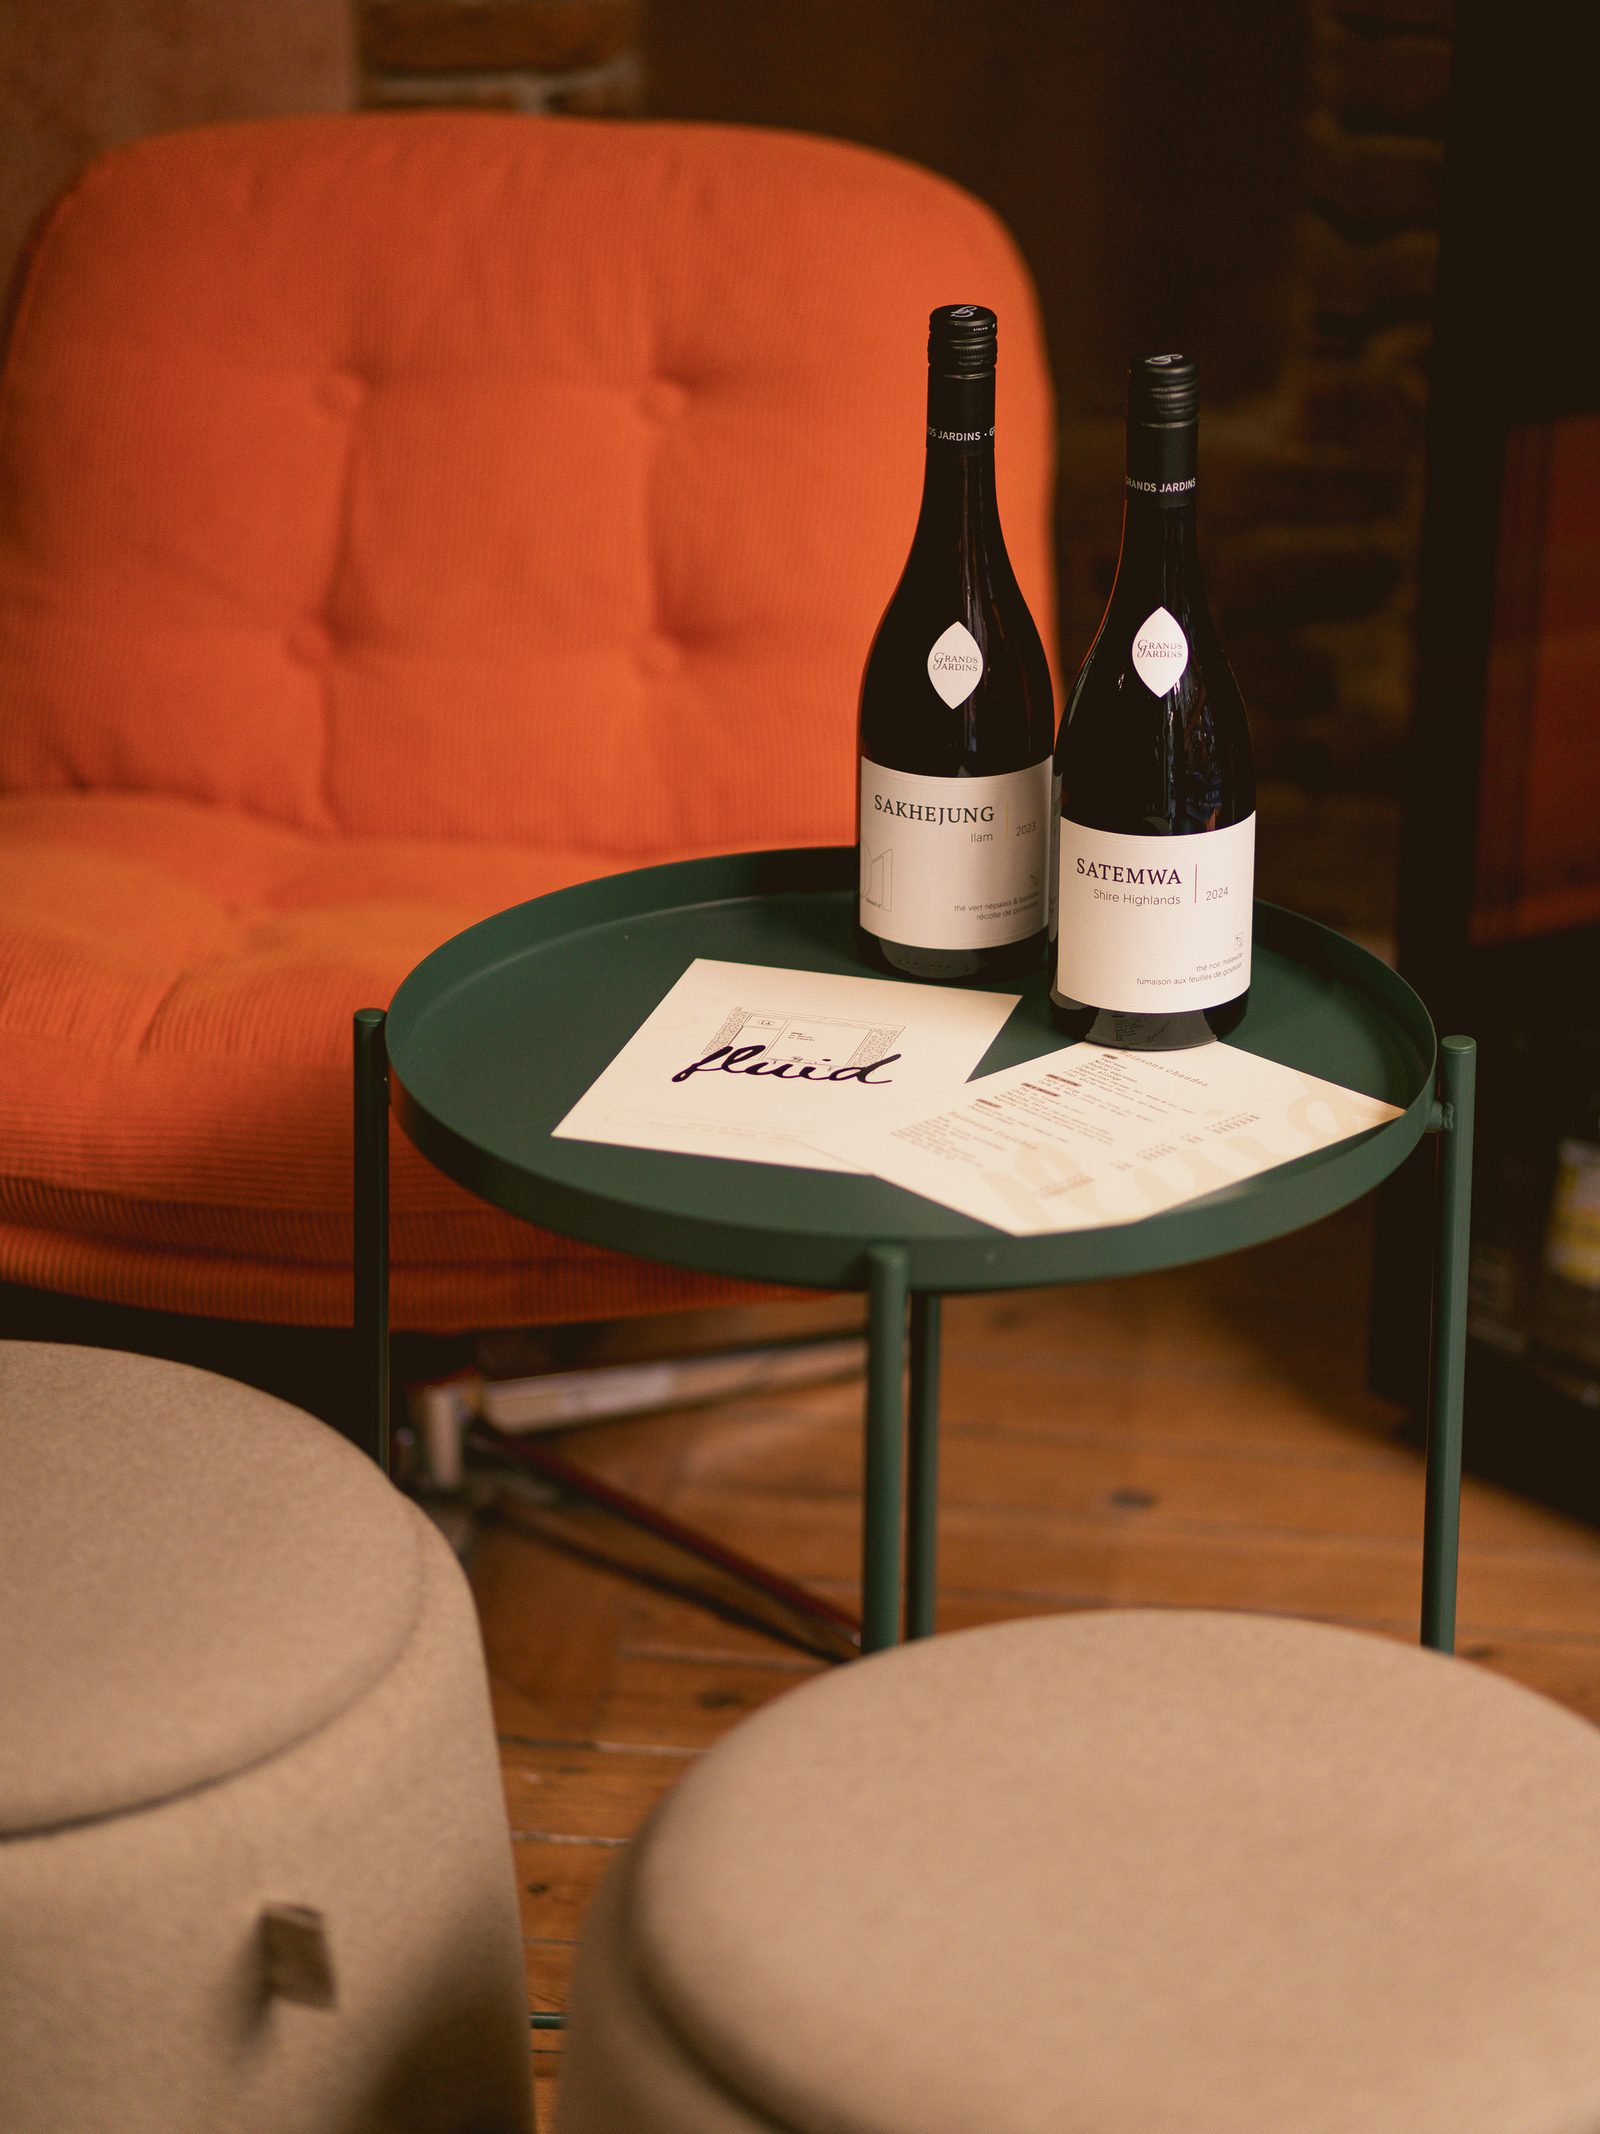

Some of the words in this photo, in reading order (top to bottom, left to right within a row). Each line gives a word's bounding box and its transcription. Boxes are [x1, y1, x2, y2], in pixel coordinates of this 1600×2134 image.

[938, 430, 981, 441] JARDINS
[1159, 477, 1196, 493] JARDINS
[1137, 638, 1183, 651] GRANDS
[933, 651, 979, 664] GRANDS
[1136, 648, 1183, 659] JARDINS
[933, 660, 978, 672] JARDINS
[874, 794, 995, 826] SAKHEJUNG
[970, 832, 993, 843] Ilam
[1015, 821, 1037, 837] 2023
[1076, 857, 1183, 885] SATEMWA
[1093, 888, 1120, 903] Shire
[1123, 893, 1181, 907] Highlands
[1205, 886, 1229, 901] 2024
[953, 904, 967, 912] thé
[1196, 963, 1208, 973] thé
[671, 1044, 902, 1085] fluid
